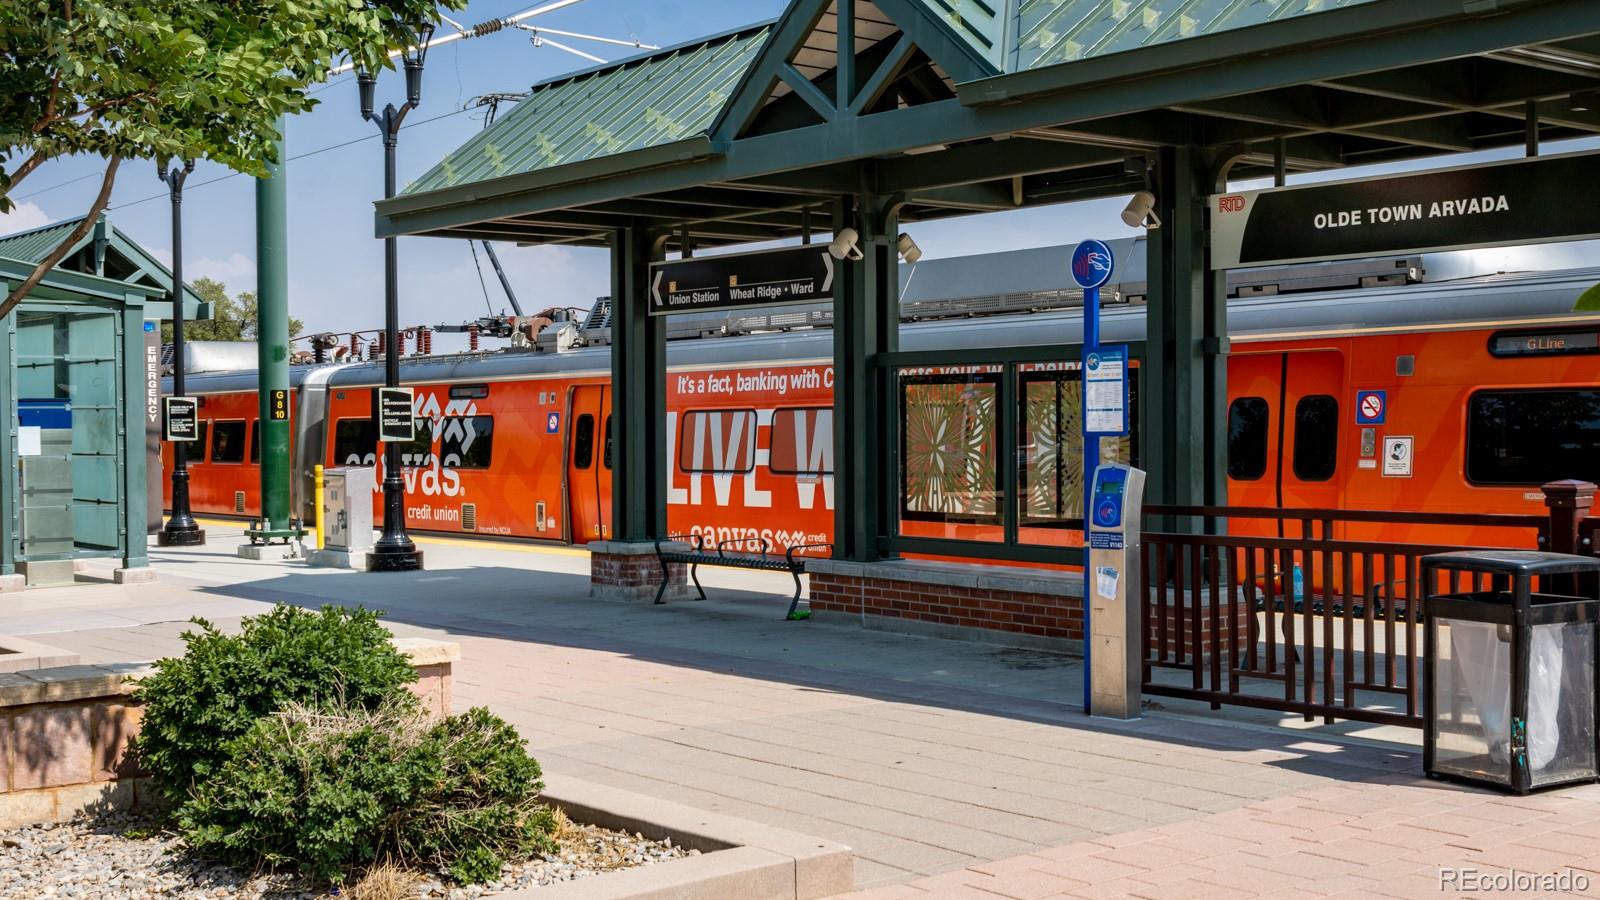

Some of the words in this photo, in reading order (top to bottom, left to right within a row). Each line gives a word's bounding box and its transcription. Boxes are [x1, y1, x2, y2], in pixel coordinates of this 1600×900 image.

[1218, 195, 1246, 212] RTD
[1313, 210, 1362, 229] OLDE
[1367, 204, 1422, 224] TOWN
[1428, 195, 1510, 218] ARVADA
[669, 294, 691, 305] Union
[692, 291, 720, 304] Station
[730, 286, 756, 300] Wheat
[757, 284, 782, 299] Ridge
[790, 281, 814, 295] Ward
[1527, 338, 1537, 350] G
[1538, 338, 1565, 349] Line
[147, 346, 158, 422] EMERGENCY
[677, 375, 695, 394] It's
[697, 379, 705, 393] a
[707, 374, 734, 396] fact,
[736, 371, 788, 395] banking
[790, 368, 820, 390] with
[276, 391, 284, 400] G
[277, 401, 283, 409] 8
[275, 410, 285, 419] 10
[667, 408, 777, 508] LIVE
[346, 453, 462, 497] vas
[407, 504, 432, 520] credit
[433, 505, 459, 521] union
[690, 525, 773, 553] canvas
[807, 533, 827, 543] credit
[807, 543, 827, 553] union
